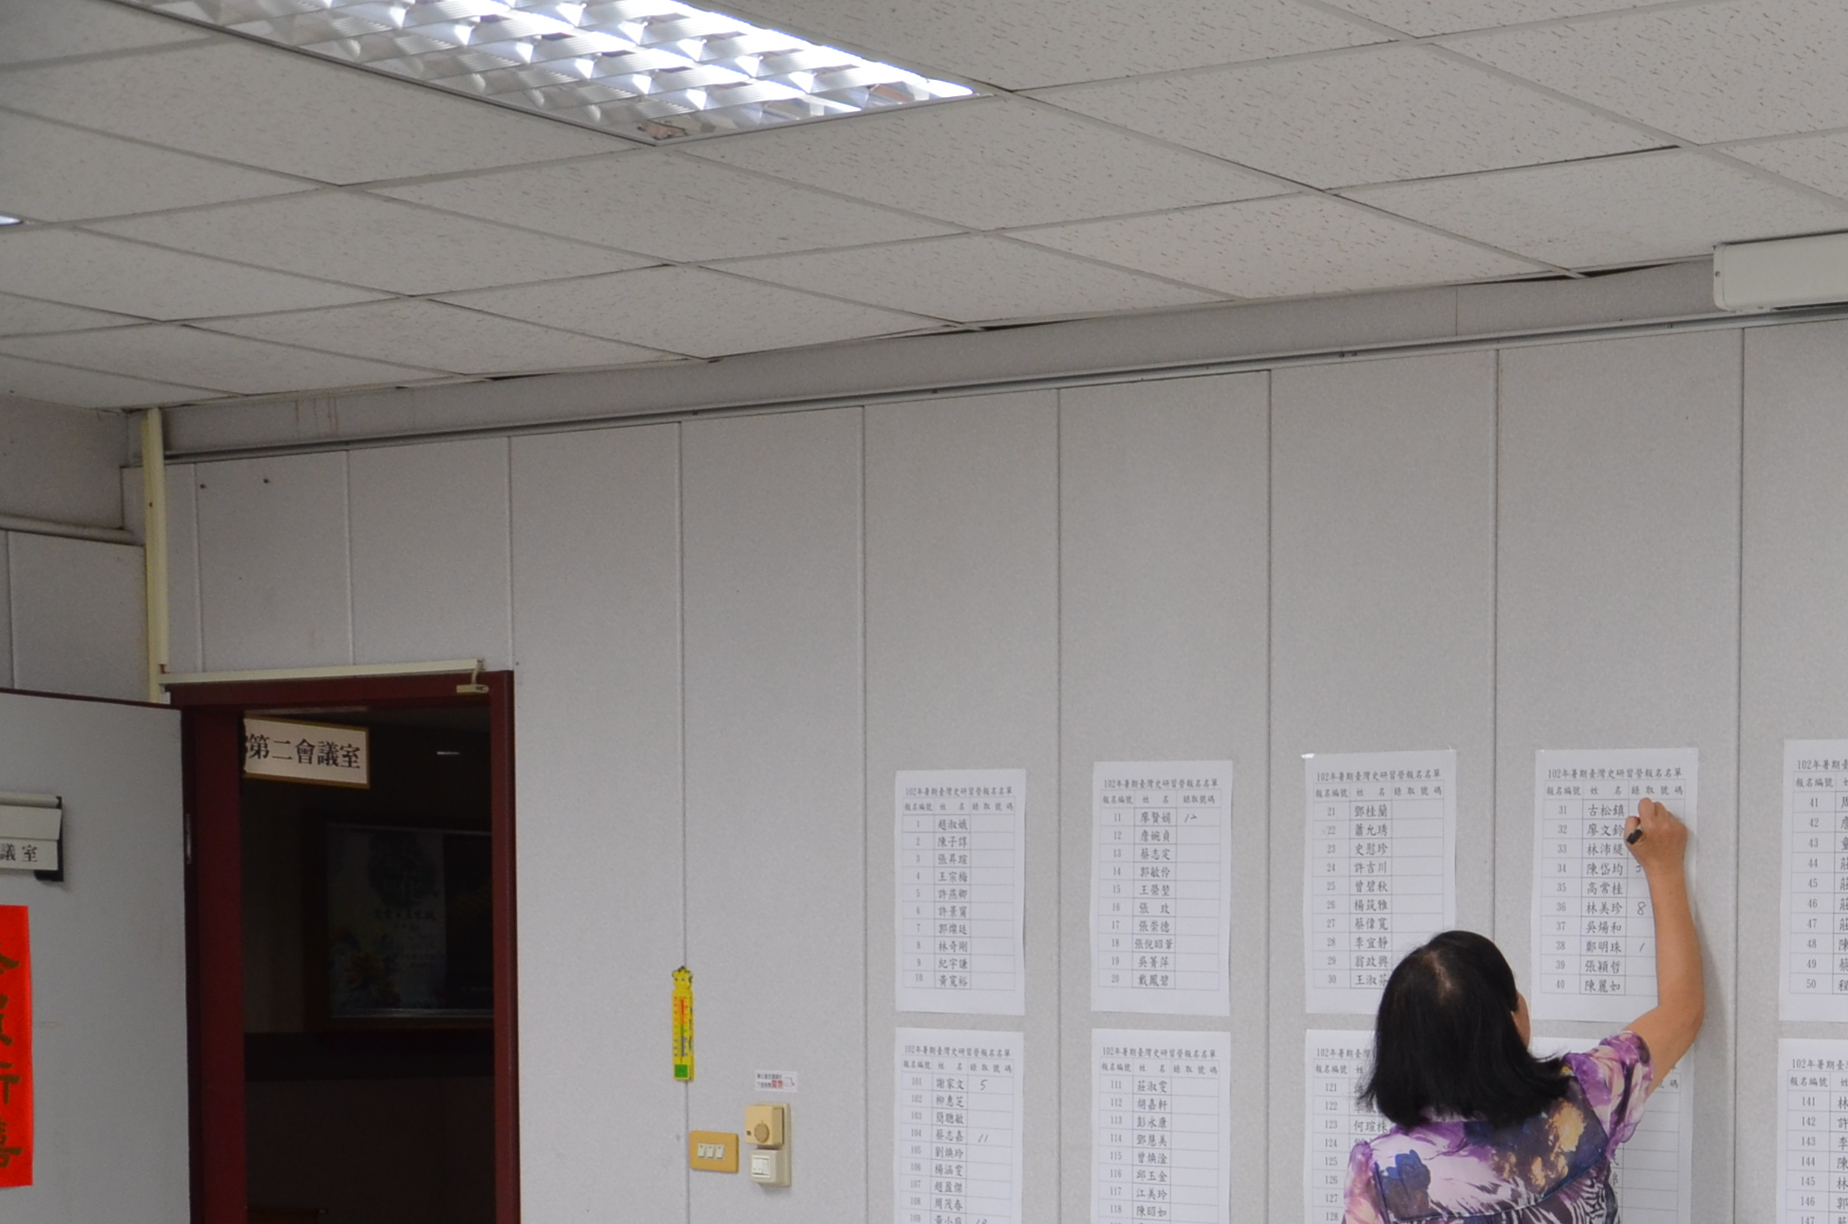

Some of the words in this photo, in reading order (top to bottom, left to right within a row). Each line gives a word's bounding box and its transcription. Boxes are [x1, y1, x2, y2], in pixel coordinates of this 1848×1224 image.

[248, 733, 361, 769] 第二會議室
[1547, 768, 1682, 780] 102年暑期臺灣史研習營報名名單
[1113, 813, 1122, 822] 11
[1557, 863, 1567, 873] 34
[1556, 902, 1567, 912] 36
[1586, 902, 1623, 914] 林美珍
[1637, 901, 1646, 916] 8
[1555, 941, 1566, 950] 38
[1806, 959, 1818, 968] 49
[911, 1077, 923, 1086] 101
[1324, 1083, 1338, 1092] 121
[1801, 1097, 1816, 1106] 141
[910, 1129, 923, 1137] 104
[909, 1214, 922, 1222] 109
